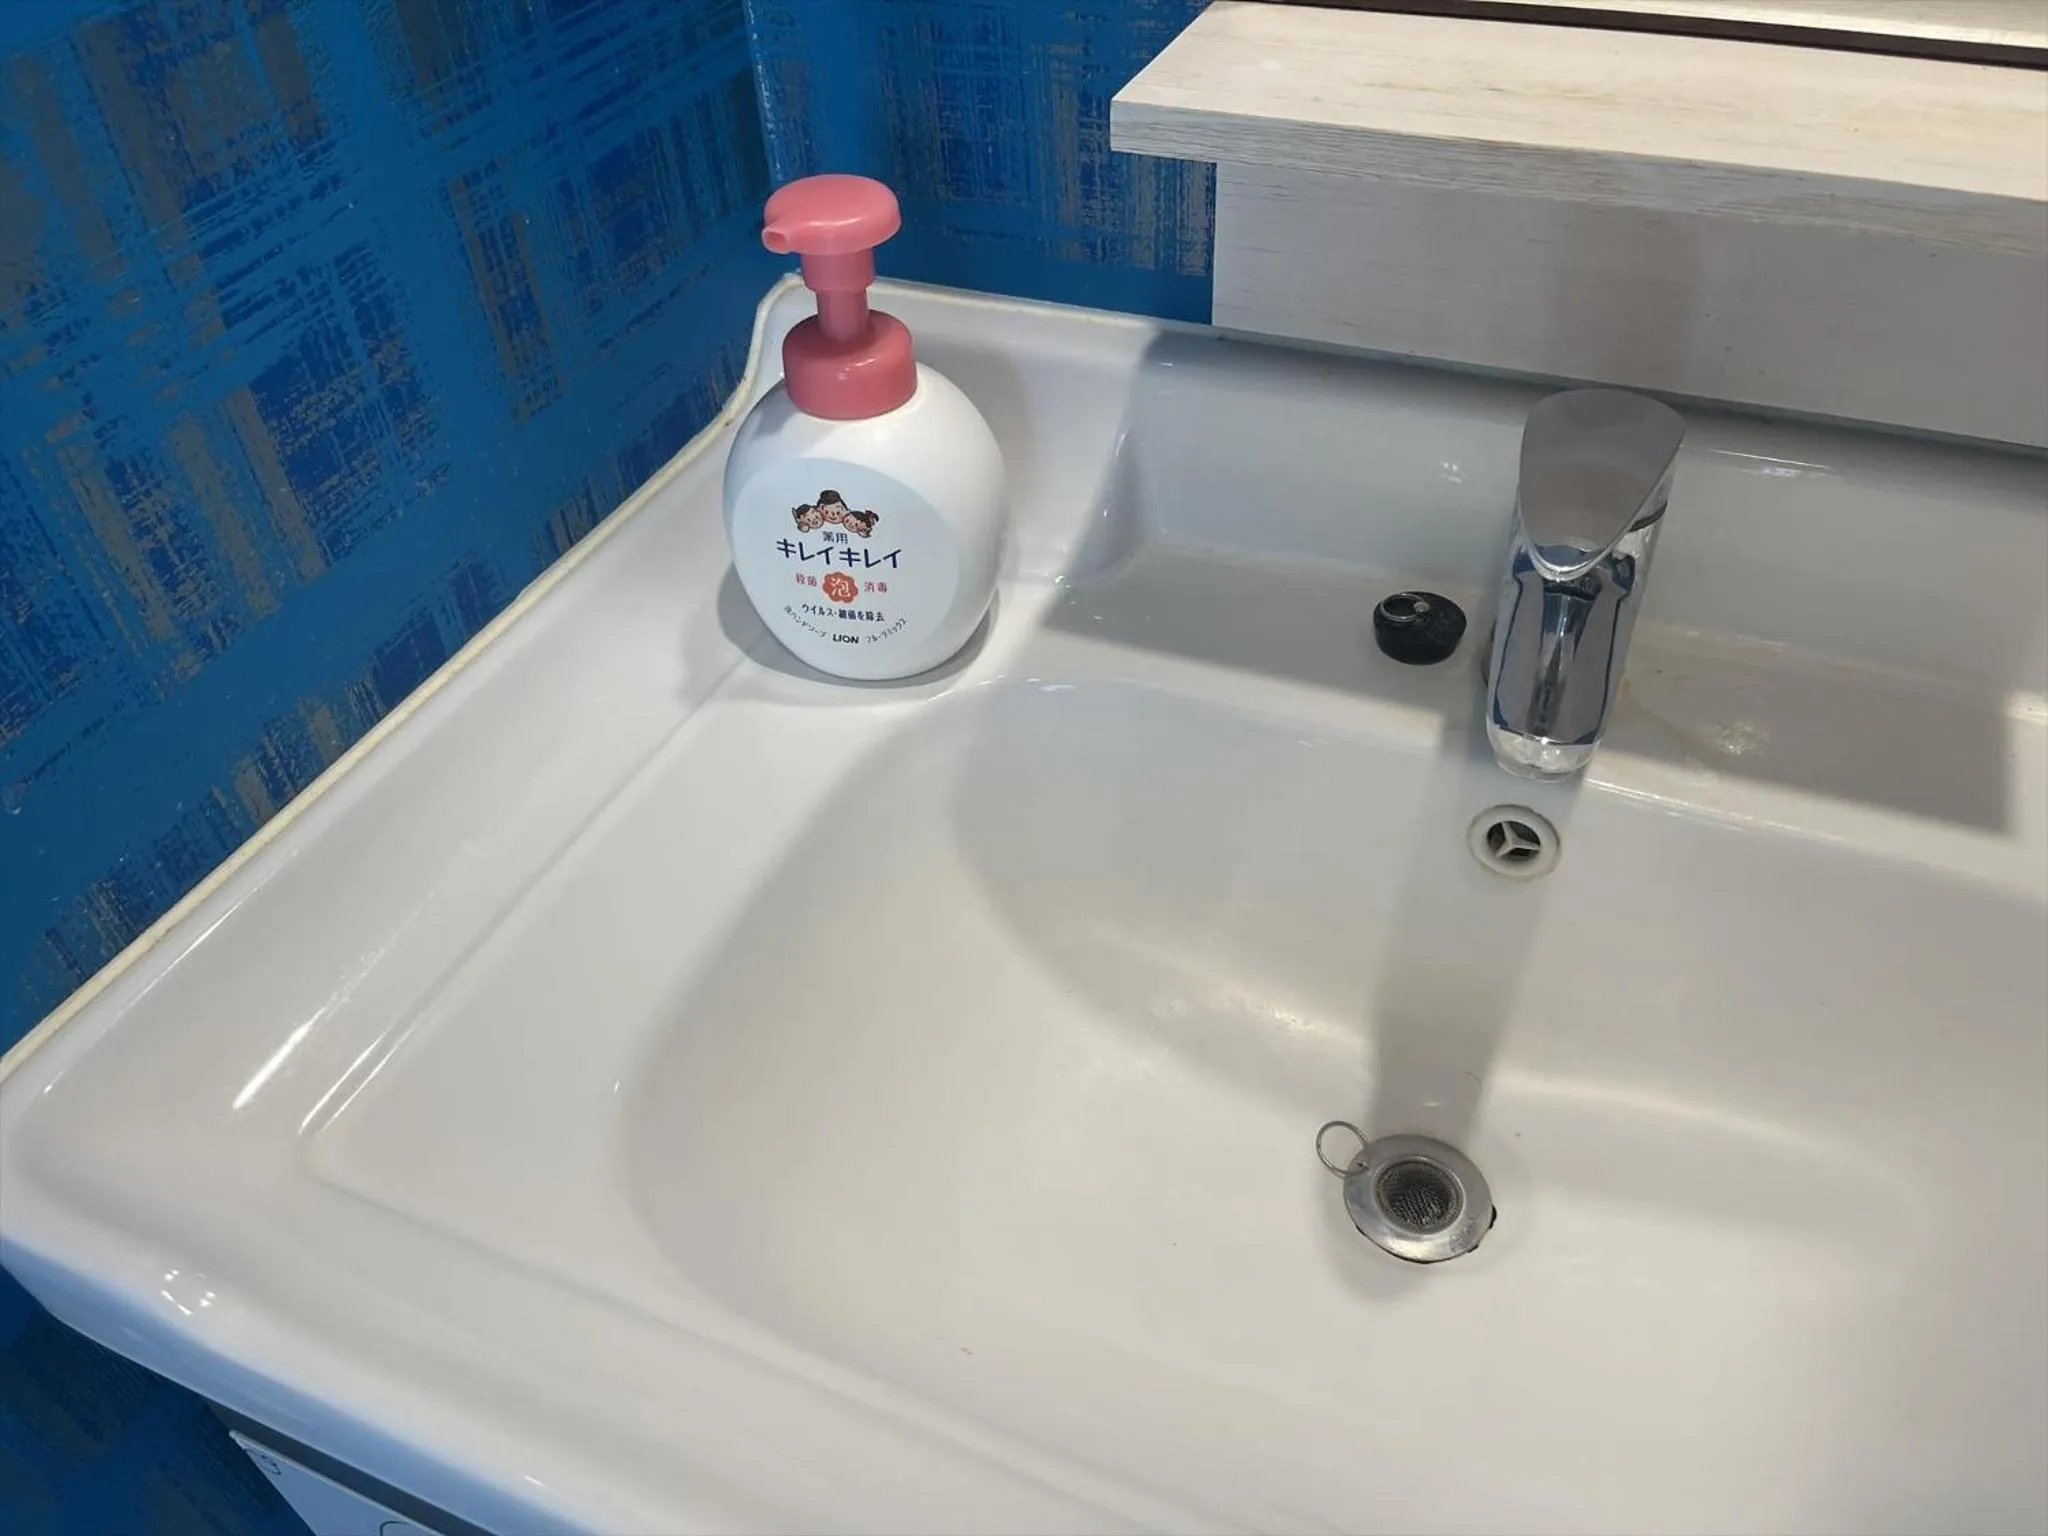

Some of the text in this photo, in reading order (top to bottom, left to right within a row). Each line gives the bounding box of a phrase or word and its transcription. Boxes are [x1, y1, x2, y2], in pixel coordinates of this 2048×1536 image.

[822, 531, 849, 544] 薬用
[777, 538, 902, 568] キレイキレイ
[795, 573, 888, 598] 殺菌 泡 消毒
[832, 634, 859, 644] LION
